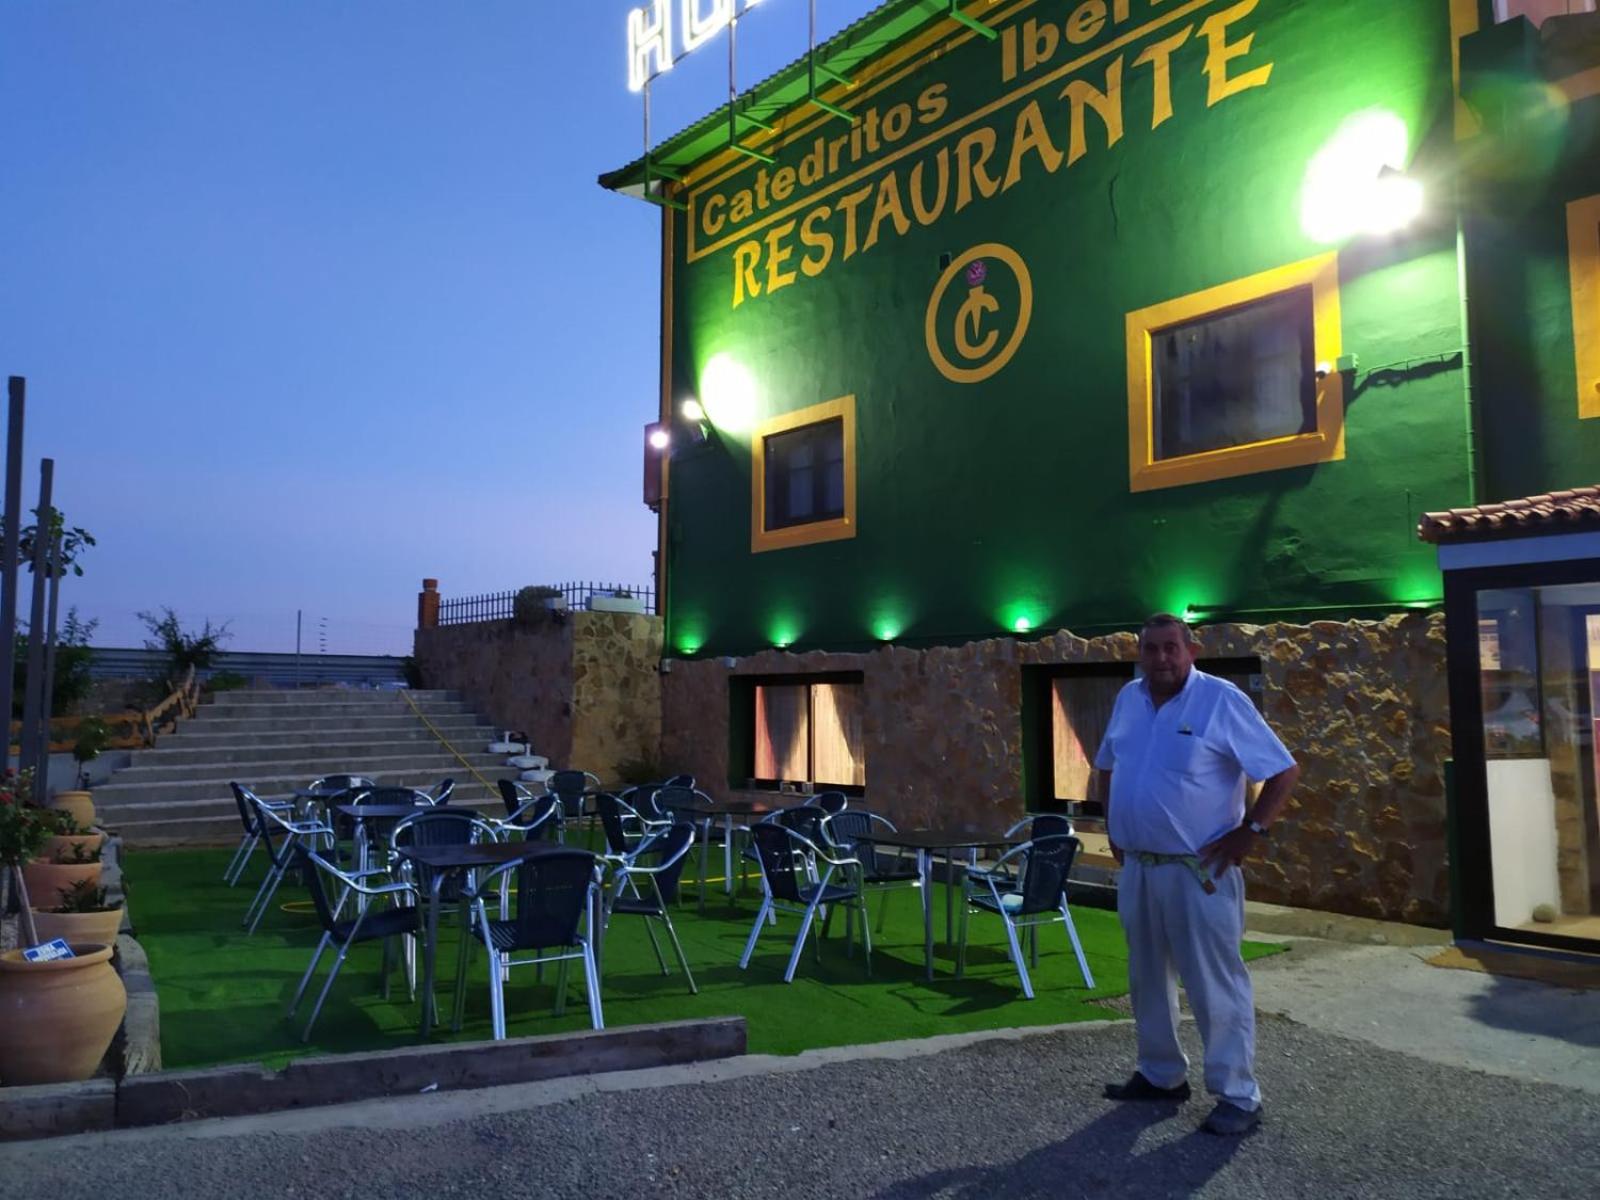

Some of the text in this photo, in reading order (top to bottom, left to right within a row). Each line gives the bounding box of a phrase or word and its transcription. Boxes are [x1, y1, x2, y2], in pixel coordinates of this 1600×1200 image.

[702, 0, 1160, 237] Catedritos Ibe
[732, 0, 1275, 310] RESTAURANTE
